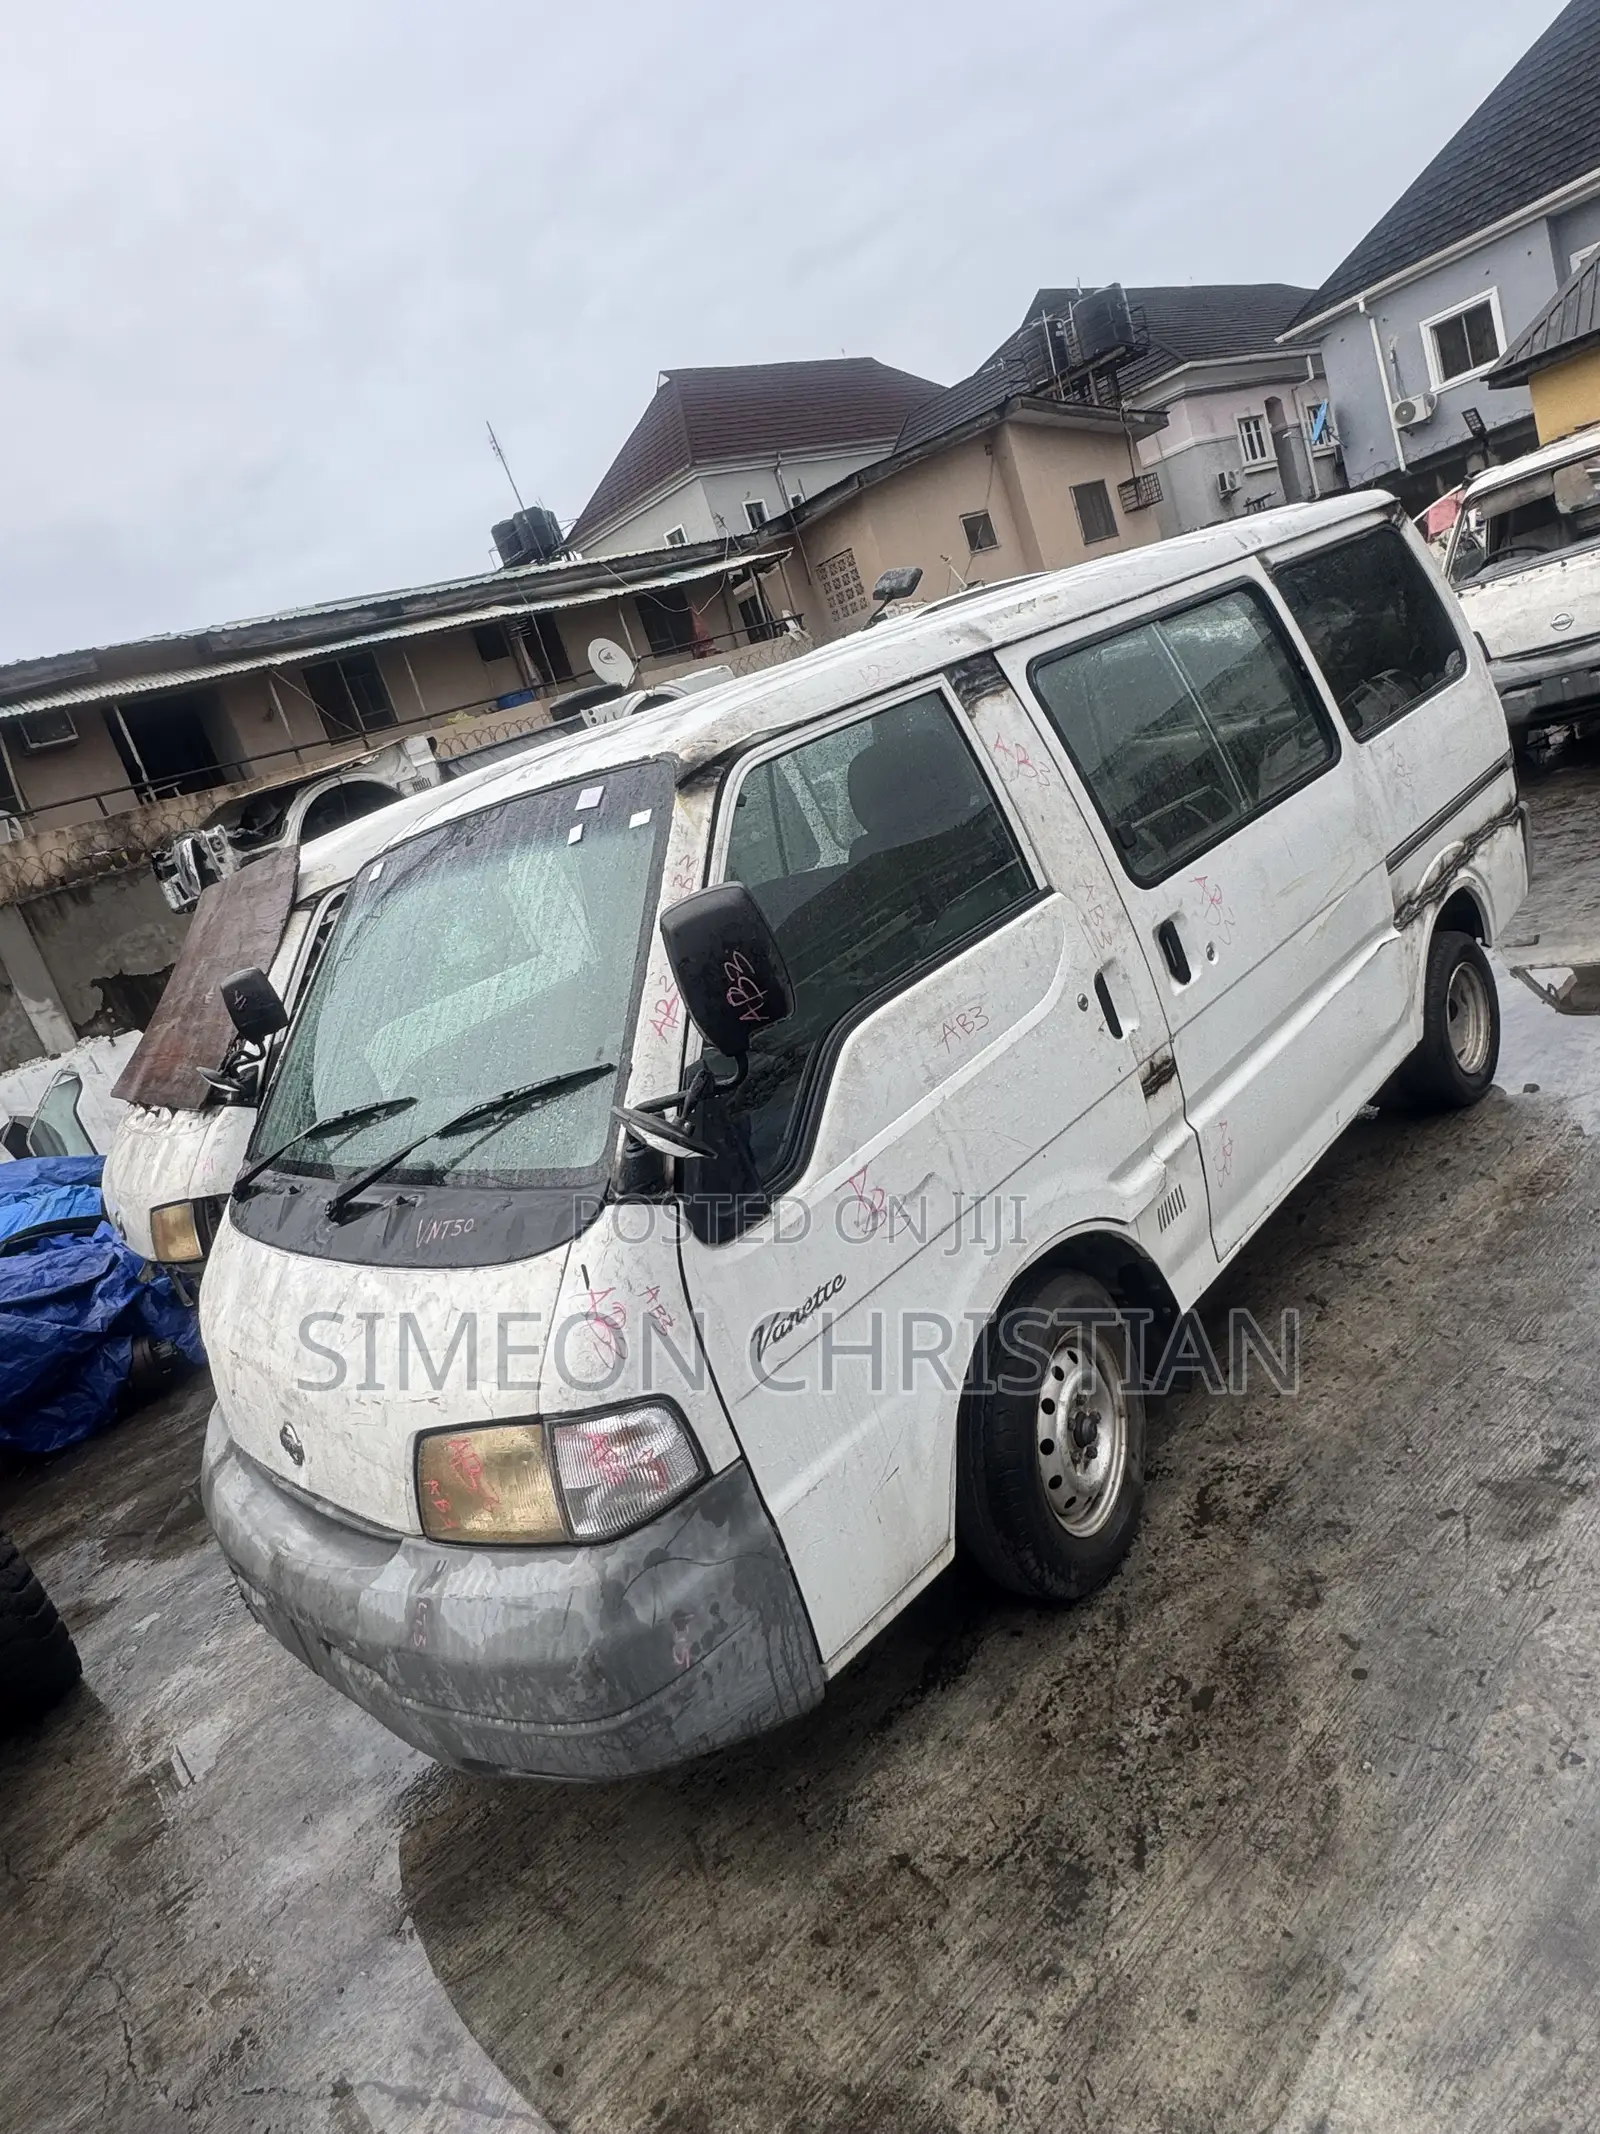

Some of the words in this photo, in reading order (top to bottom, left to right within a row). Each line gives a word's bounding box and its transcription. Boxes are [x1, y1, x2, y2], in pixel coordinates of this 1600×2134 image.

[724, 950, 770, 1022] AB3
[940, 1006, 991, 1053] AB3
[416, 1217, 475, 1249] VNT50
[752, 1272, 847, 1363] Vanette
